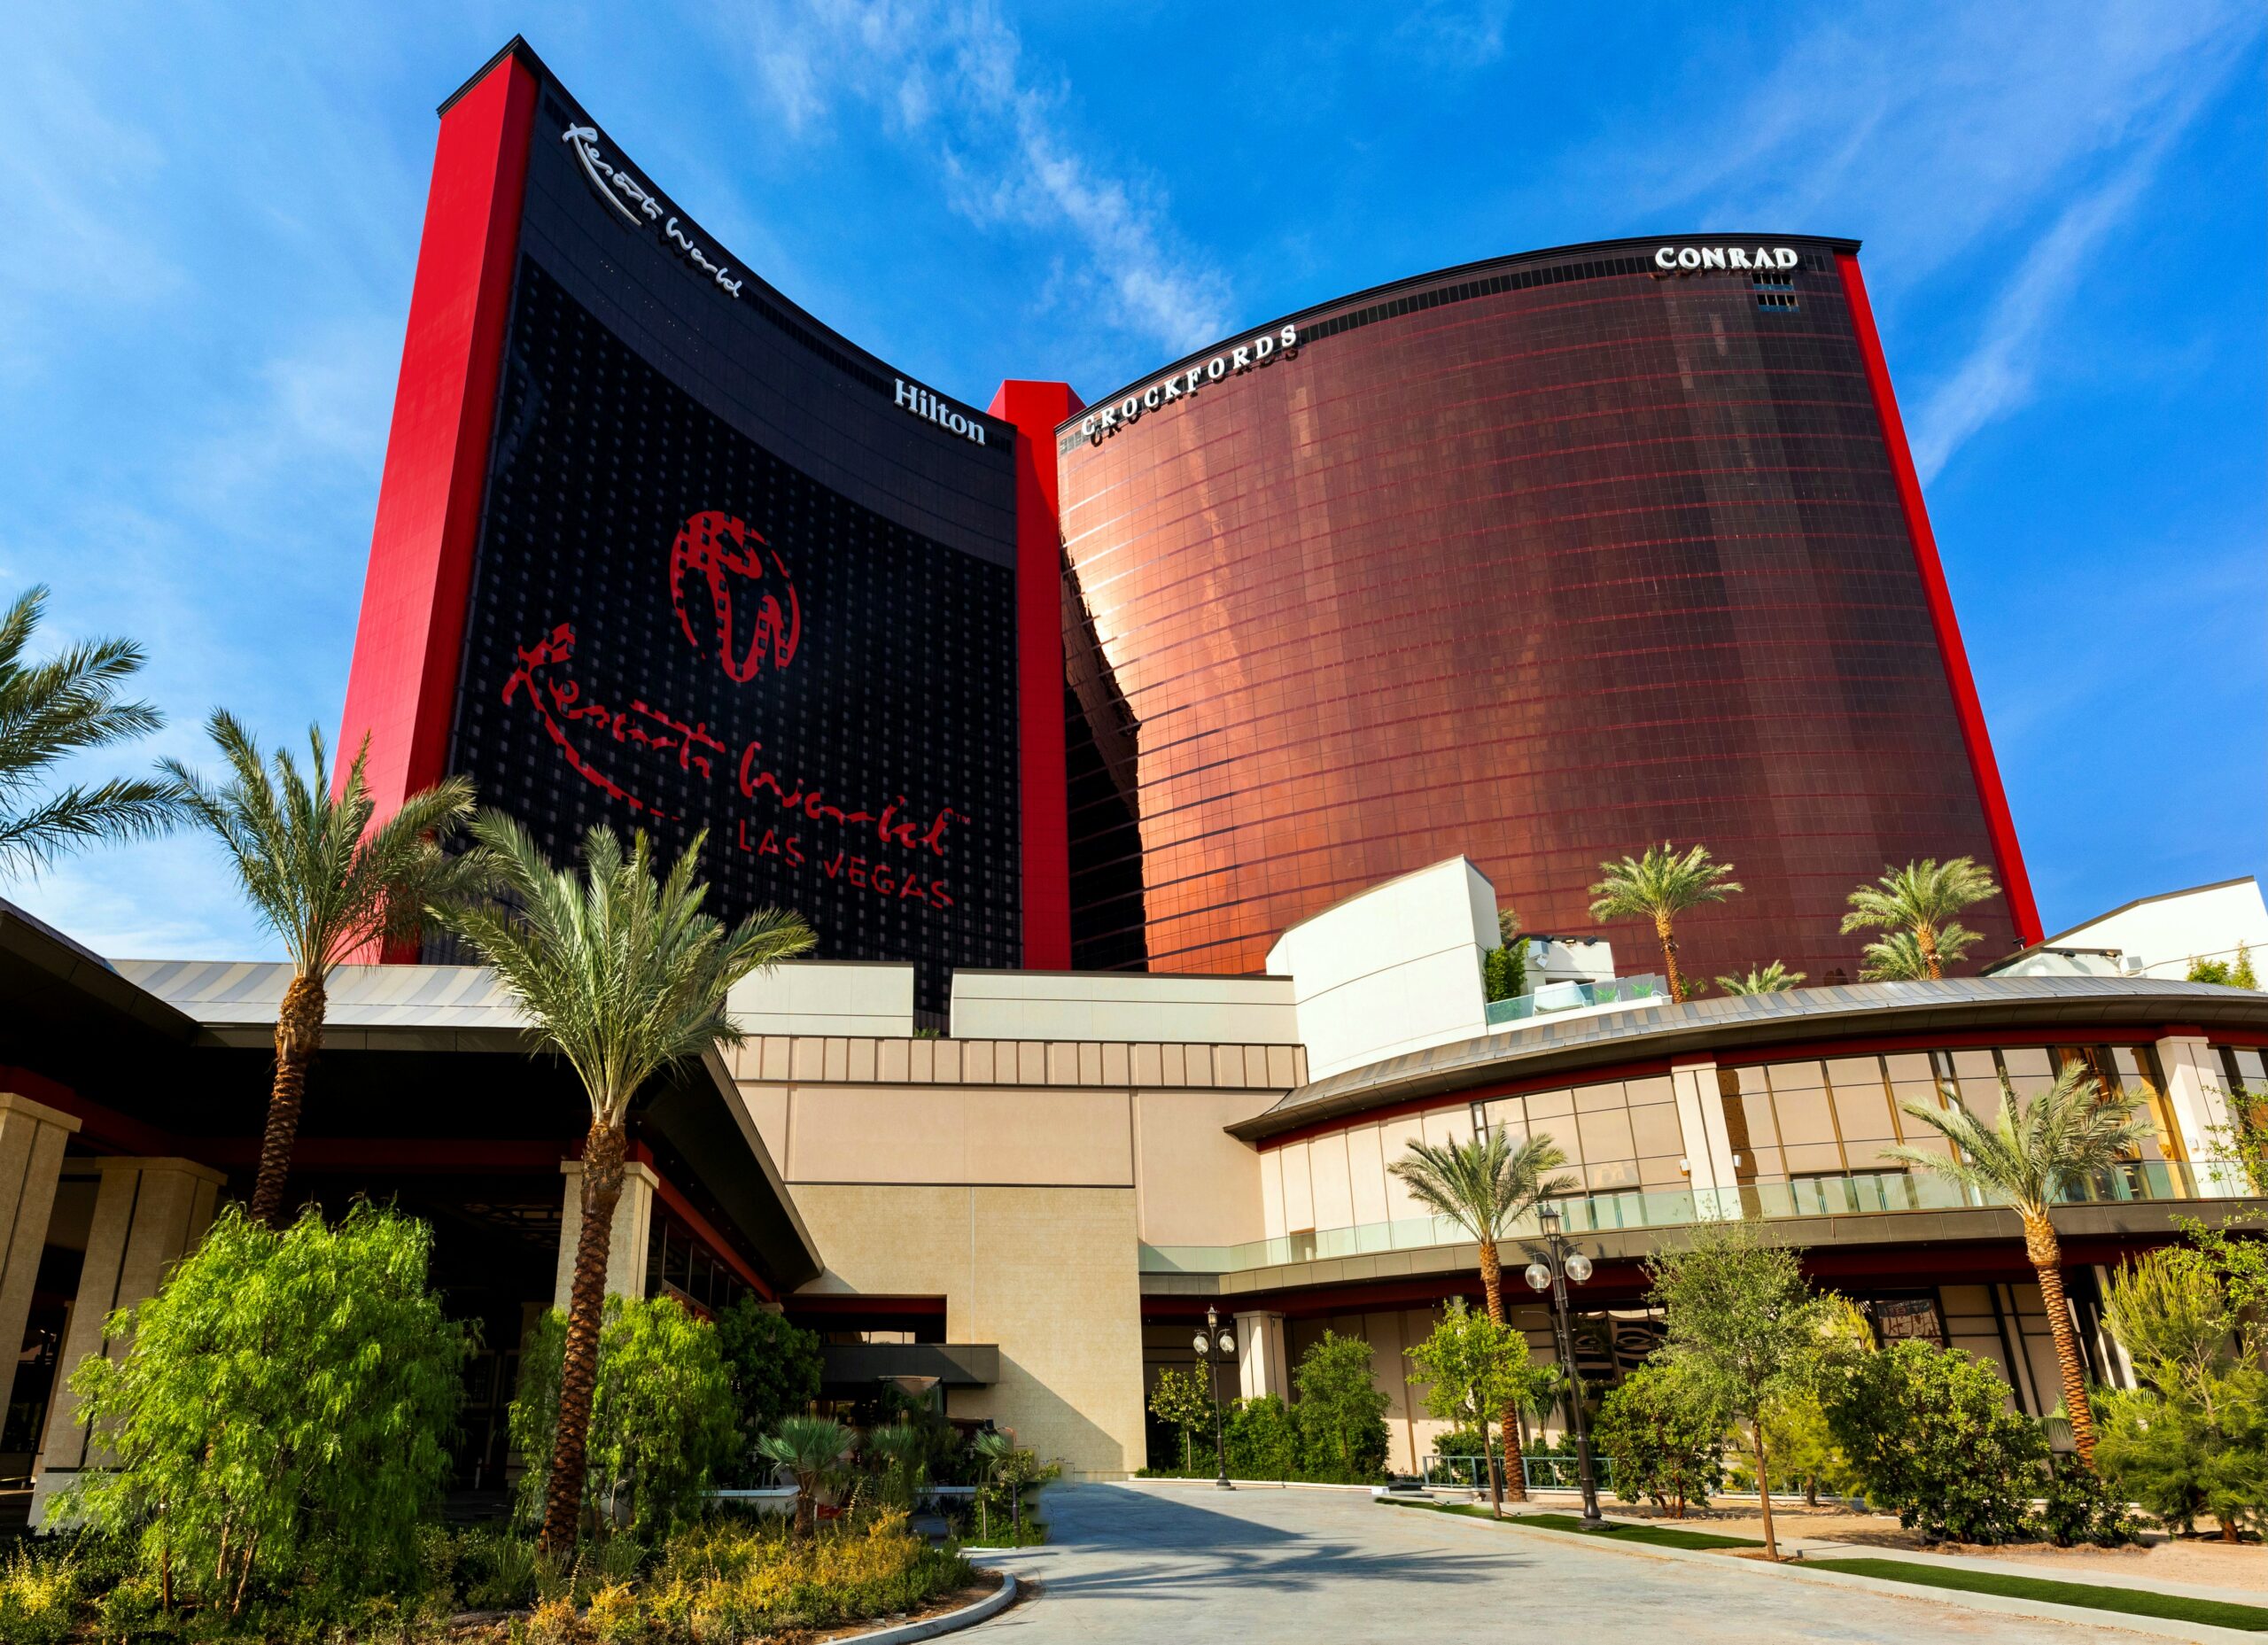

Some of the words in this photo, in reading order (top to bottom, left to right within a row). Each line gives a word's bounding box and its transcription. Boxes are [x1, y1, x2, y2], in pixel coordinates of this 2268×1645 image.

[1655, 247, 1798, 269] CONRAD
[894, 378, 985, 446] Hilton
[1081, 324, 1297, 436] CROCKFORDS
[739, 819, 805, 867] LAS
[824, 852, 954, 909] VEGAS
